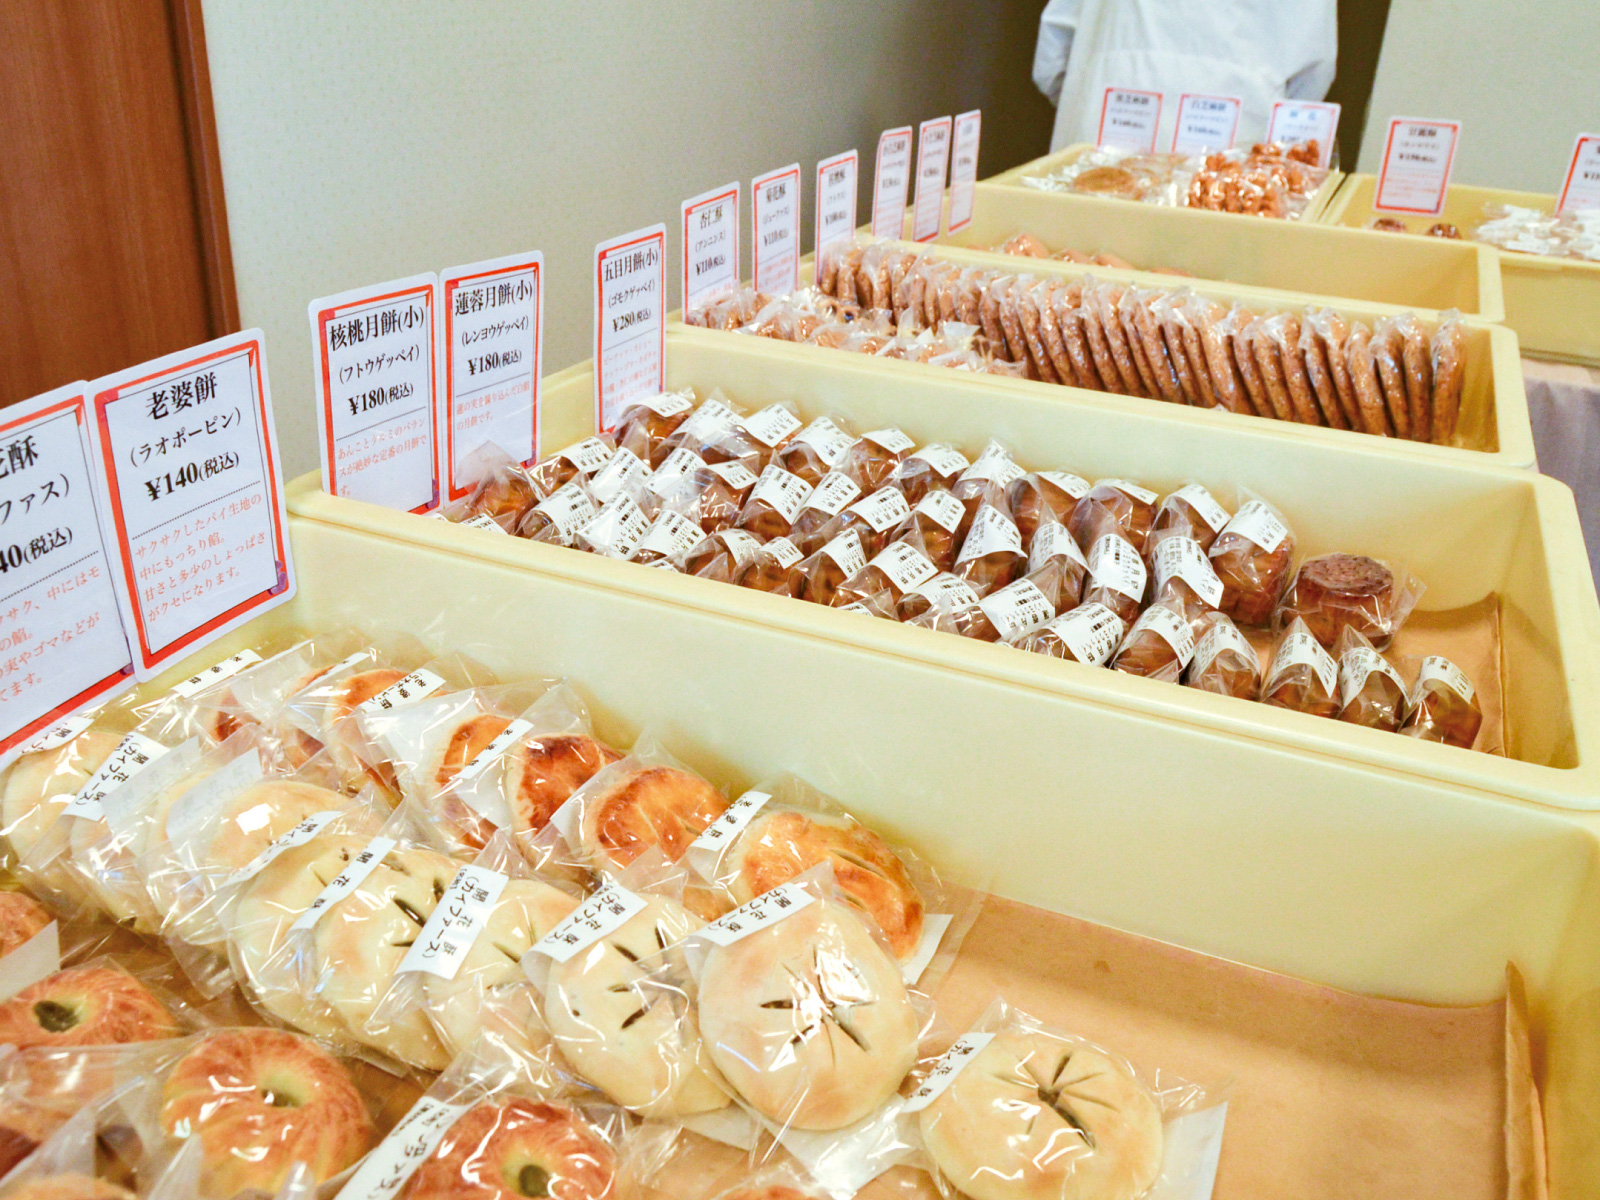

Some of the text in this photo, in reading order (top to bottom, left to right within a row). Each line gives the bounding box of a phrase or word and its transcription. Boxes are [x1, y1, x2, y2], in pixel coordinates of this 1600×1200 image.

[604, 248, 659, 282] 五目月餅(小)
[455, 279, 533, 317] 蓮蓉月餅(小)
[612, 308, 652, 333] ¥280(税込)
[329, 305, 424, 351] 核桃月餅(小)
[461, 315, 529, 347] (レンヨウゲッペイ)
[339, 344, 420, 384] (フトウゲッペイ)
[468, 350, 522, 376] ¥180(税込)
[145, 372, 218, 420] 老婆餅
[348, 383, 414, 416] ¥180(税込)
[130, 407, 241, 468] (ラオポーピン)
[144, 451, 240, 502] ¥140(税込)
[136, 493, 262, 559] サクサクしたパイ生地の
[140, 531, 225, 581] 中にもっちり餡。
[144, 532, 266, 602] 甘さと多少のしょっぱさ
[148, 567, 241, 622] がクセになります。
[75, 742, 142, 806] (カイファース)
[422, 876, 480, 958] (カイファース)
[441, 887, 490, 956] 開花酥
[544, 891, 621, 944] (カイファース)
[563, 903, 626, 945] 開花酥
[727, 896, 792, 932] 開花酥
